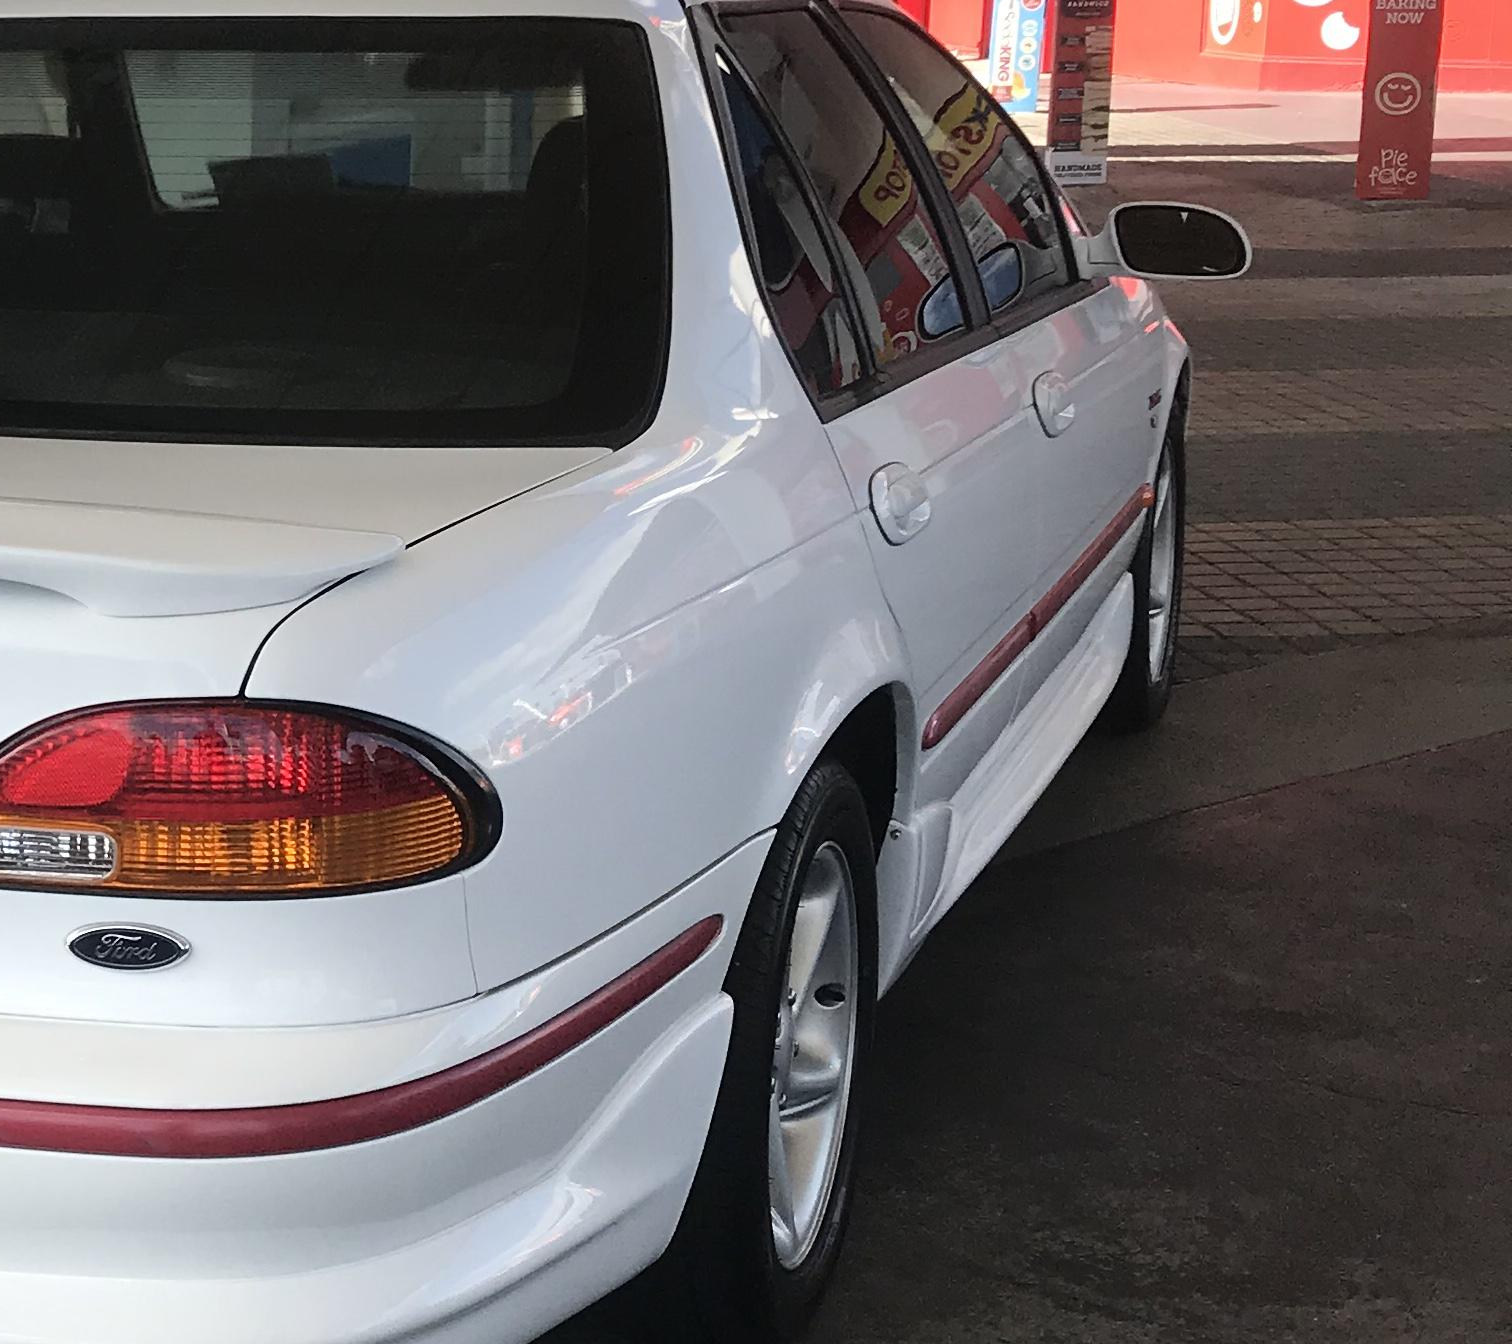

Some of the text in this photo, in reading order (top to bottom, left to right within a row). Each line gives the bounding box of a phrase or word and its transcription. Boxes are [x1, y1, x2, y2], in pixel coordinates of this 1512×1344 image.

[1385, 12, 1425, 24] NOW
[1368, 167, 1418, 187] face
[96, 933, 158, 961] Ford
